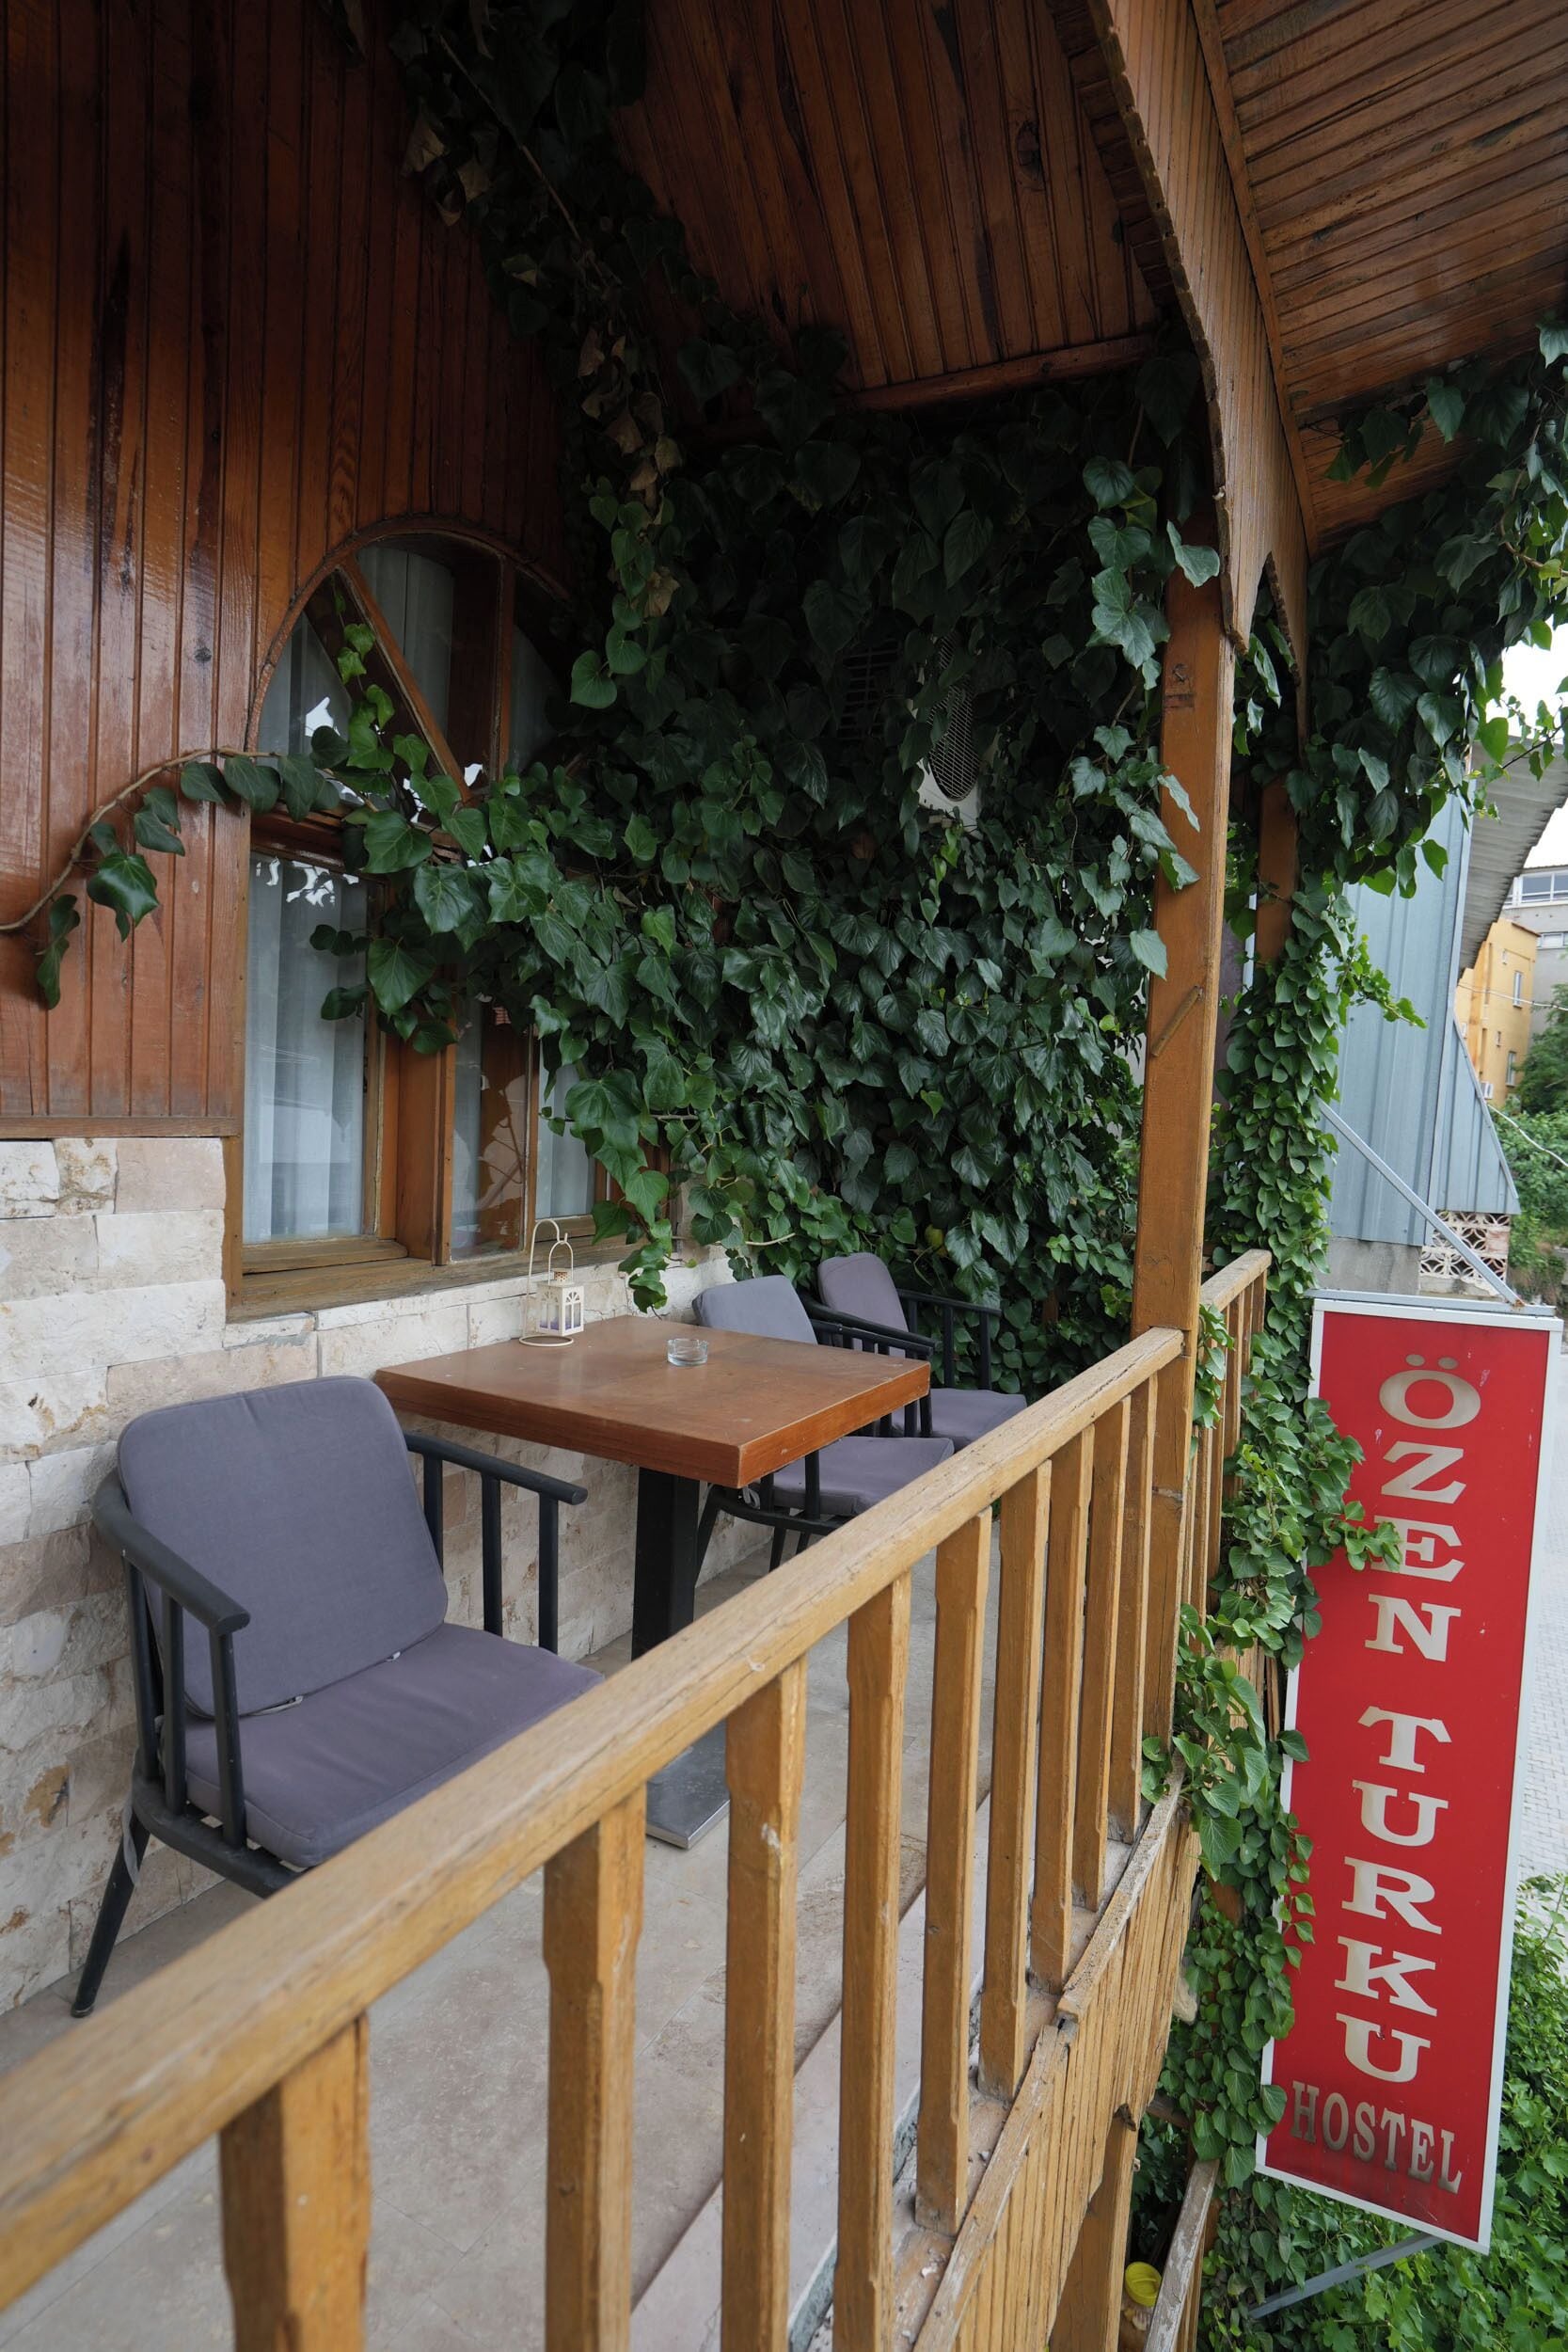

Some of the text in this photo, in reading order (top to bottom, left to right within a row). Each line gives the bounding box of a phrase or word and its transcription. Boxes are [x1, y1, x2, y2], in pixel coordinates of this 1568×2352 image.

[1335, 1354, 1481, 2083] ÖZEN TURKU
[1290, 2080, 1463, 2194] HOSTEL
